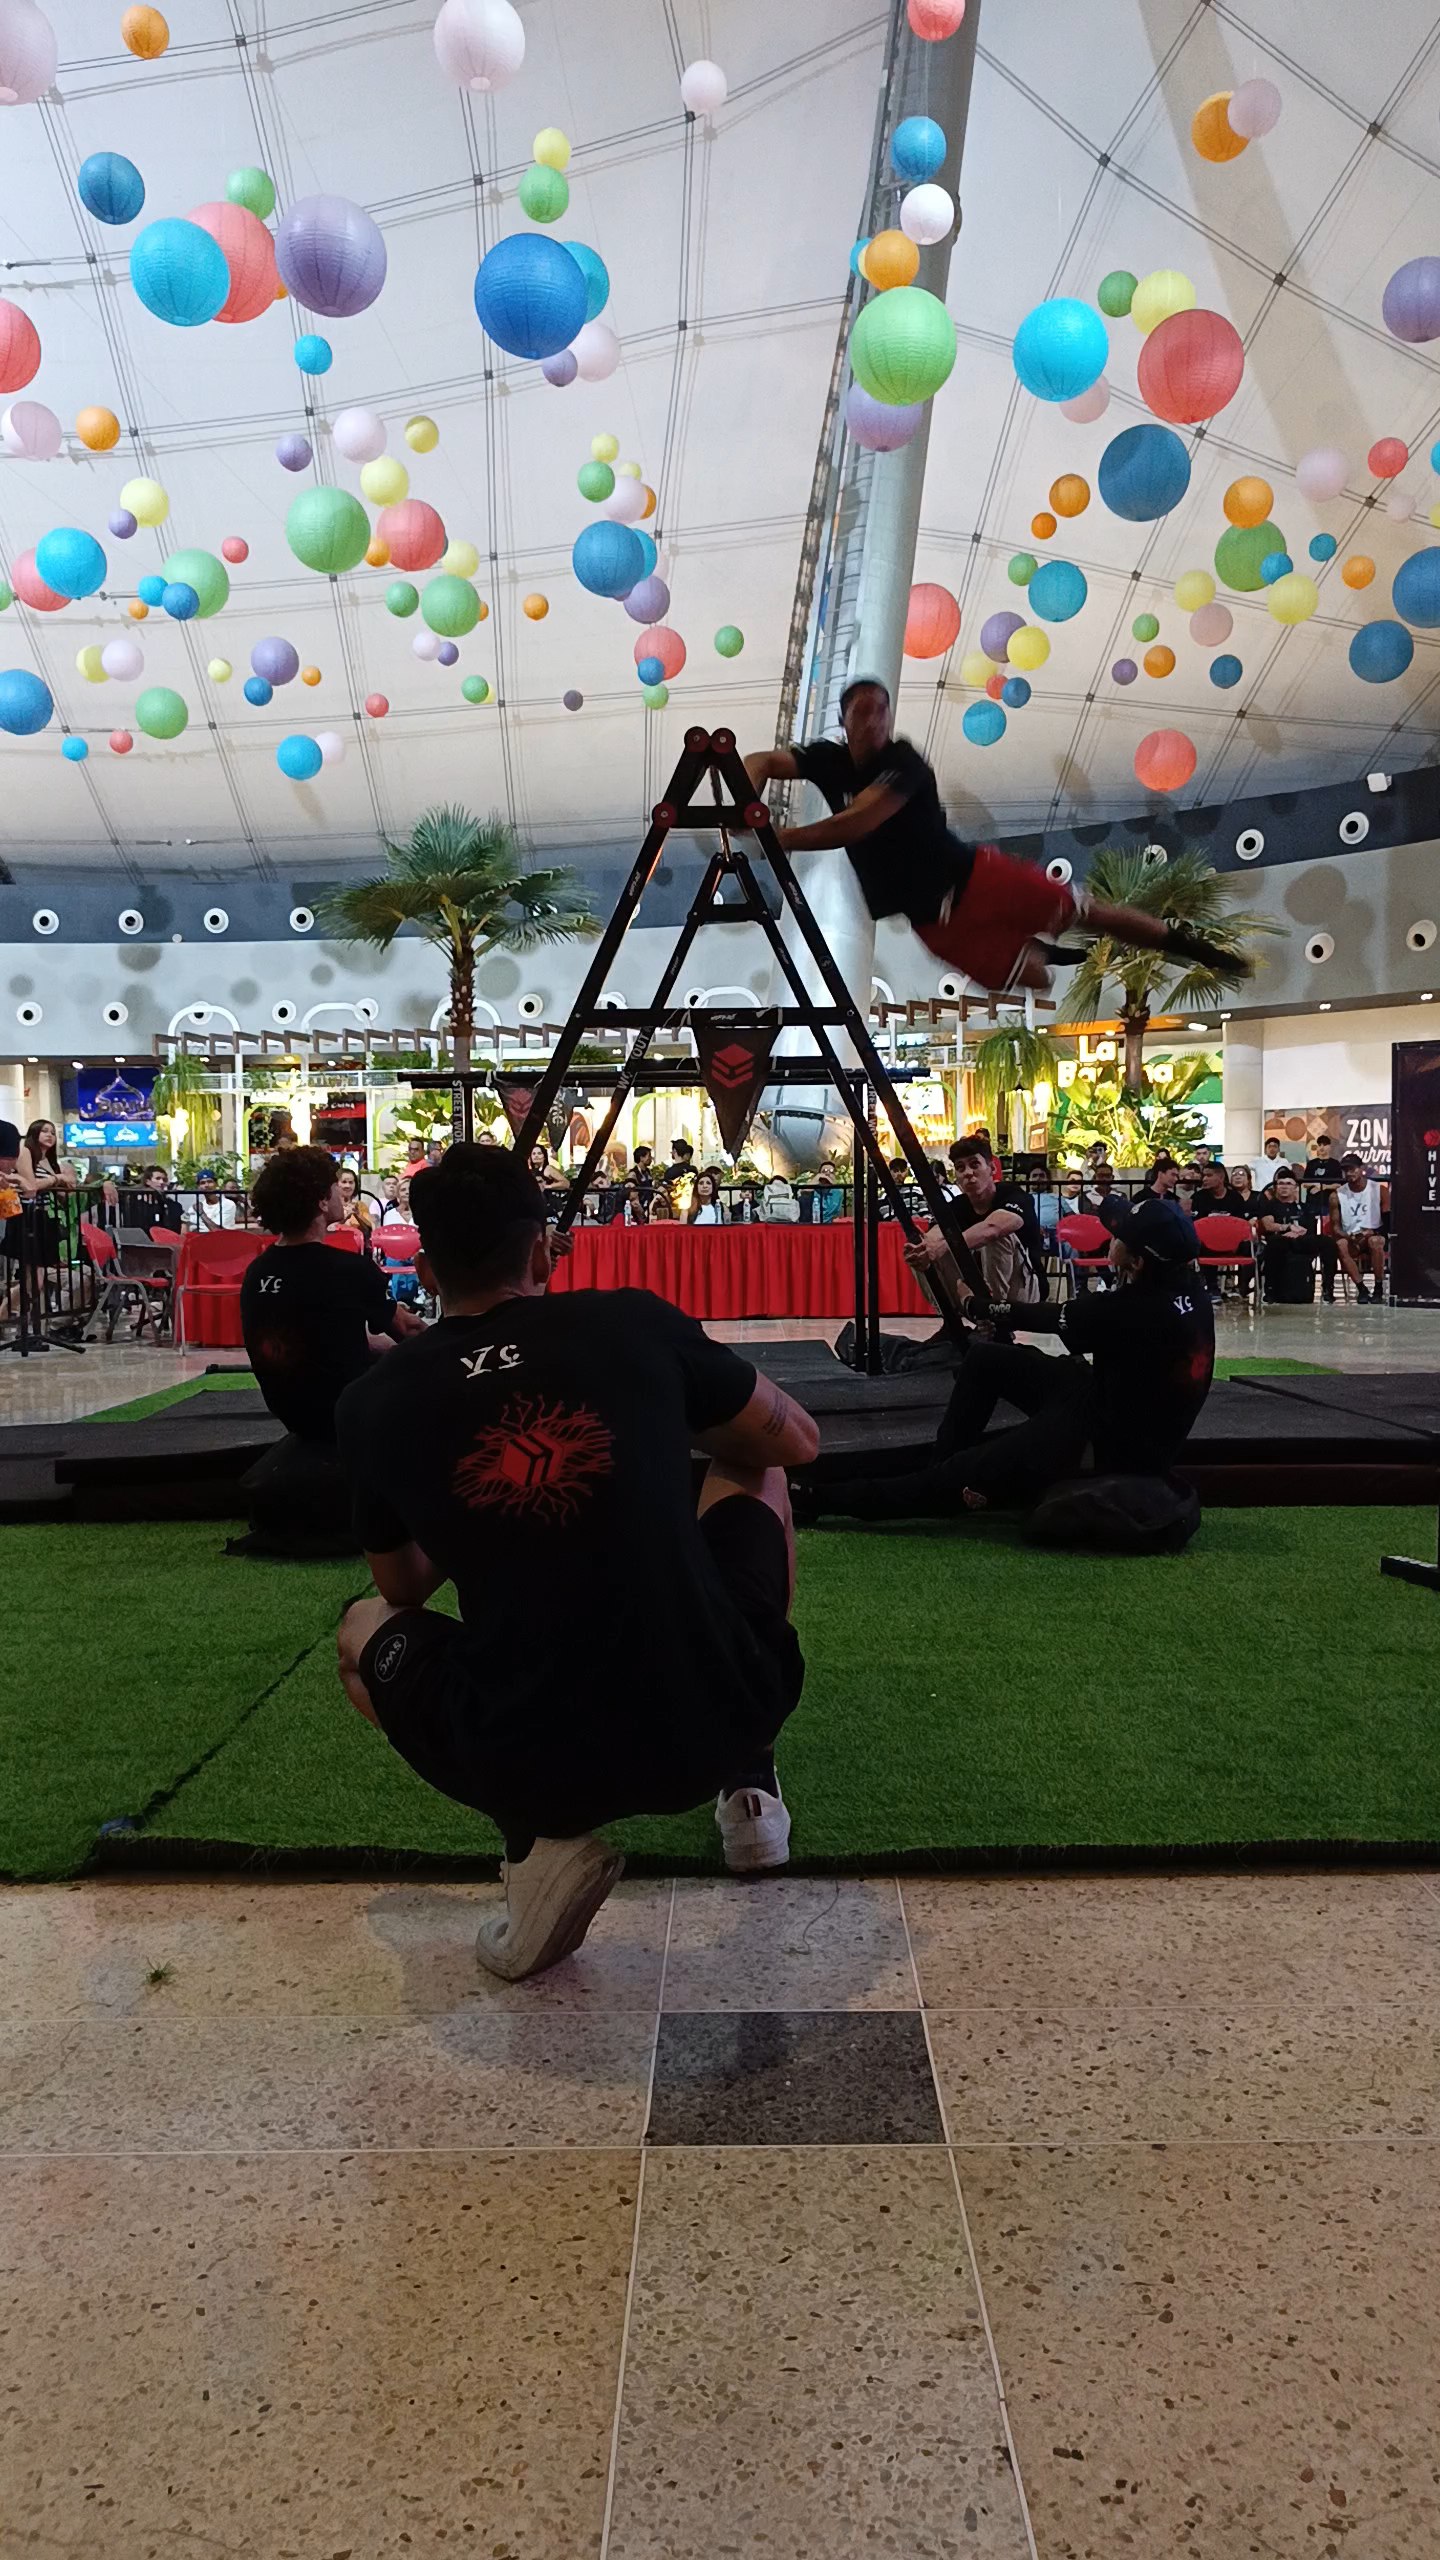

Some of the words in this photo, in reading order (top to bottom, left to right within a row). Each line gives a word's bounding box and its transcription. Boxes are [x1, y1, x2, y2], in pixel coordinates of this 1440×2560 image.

[1078, 1035, 1117, 1063] La
[451, 1079, 464, 1117] STREET
[1427, 1150, 1438, 1201] HIVE
